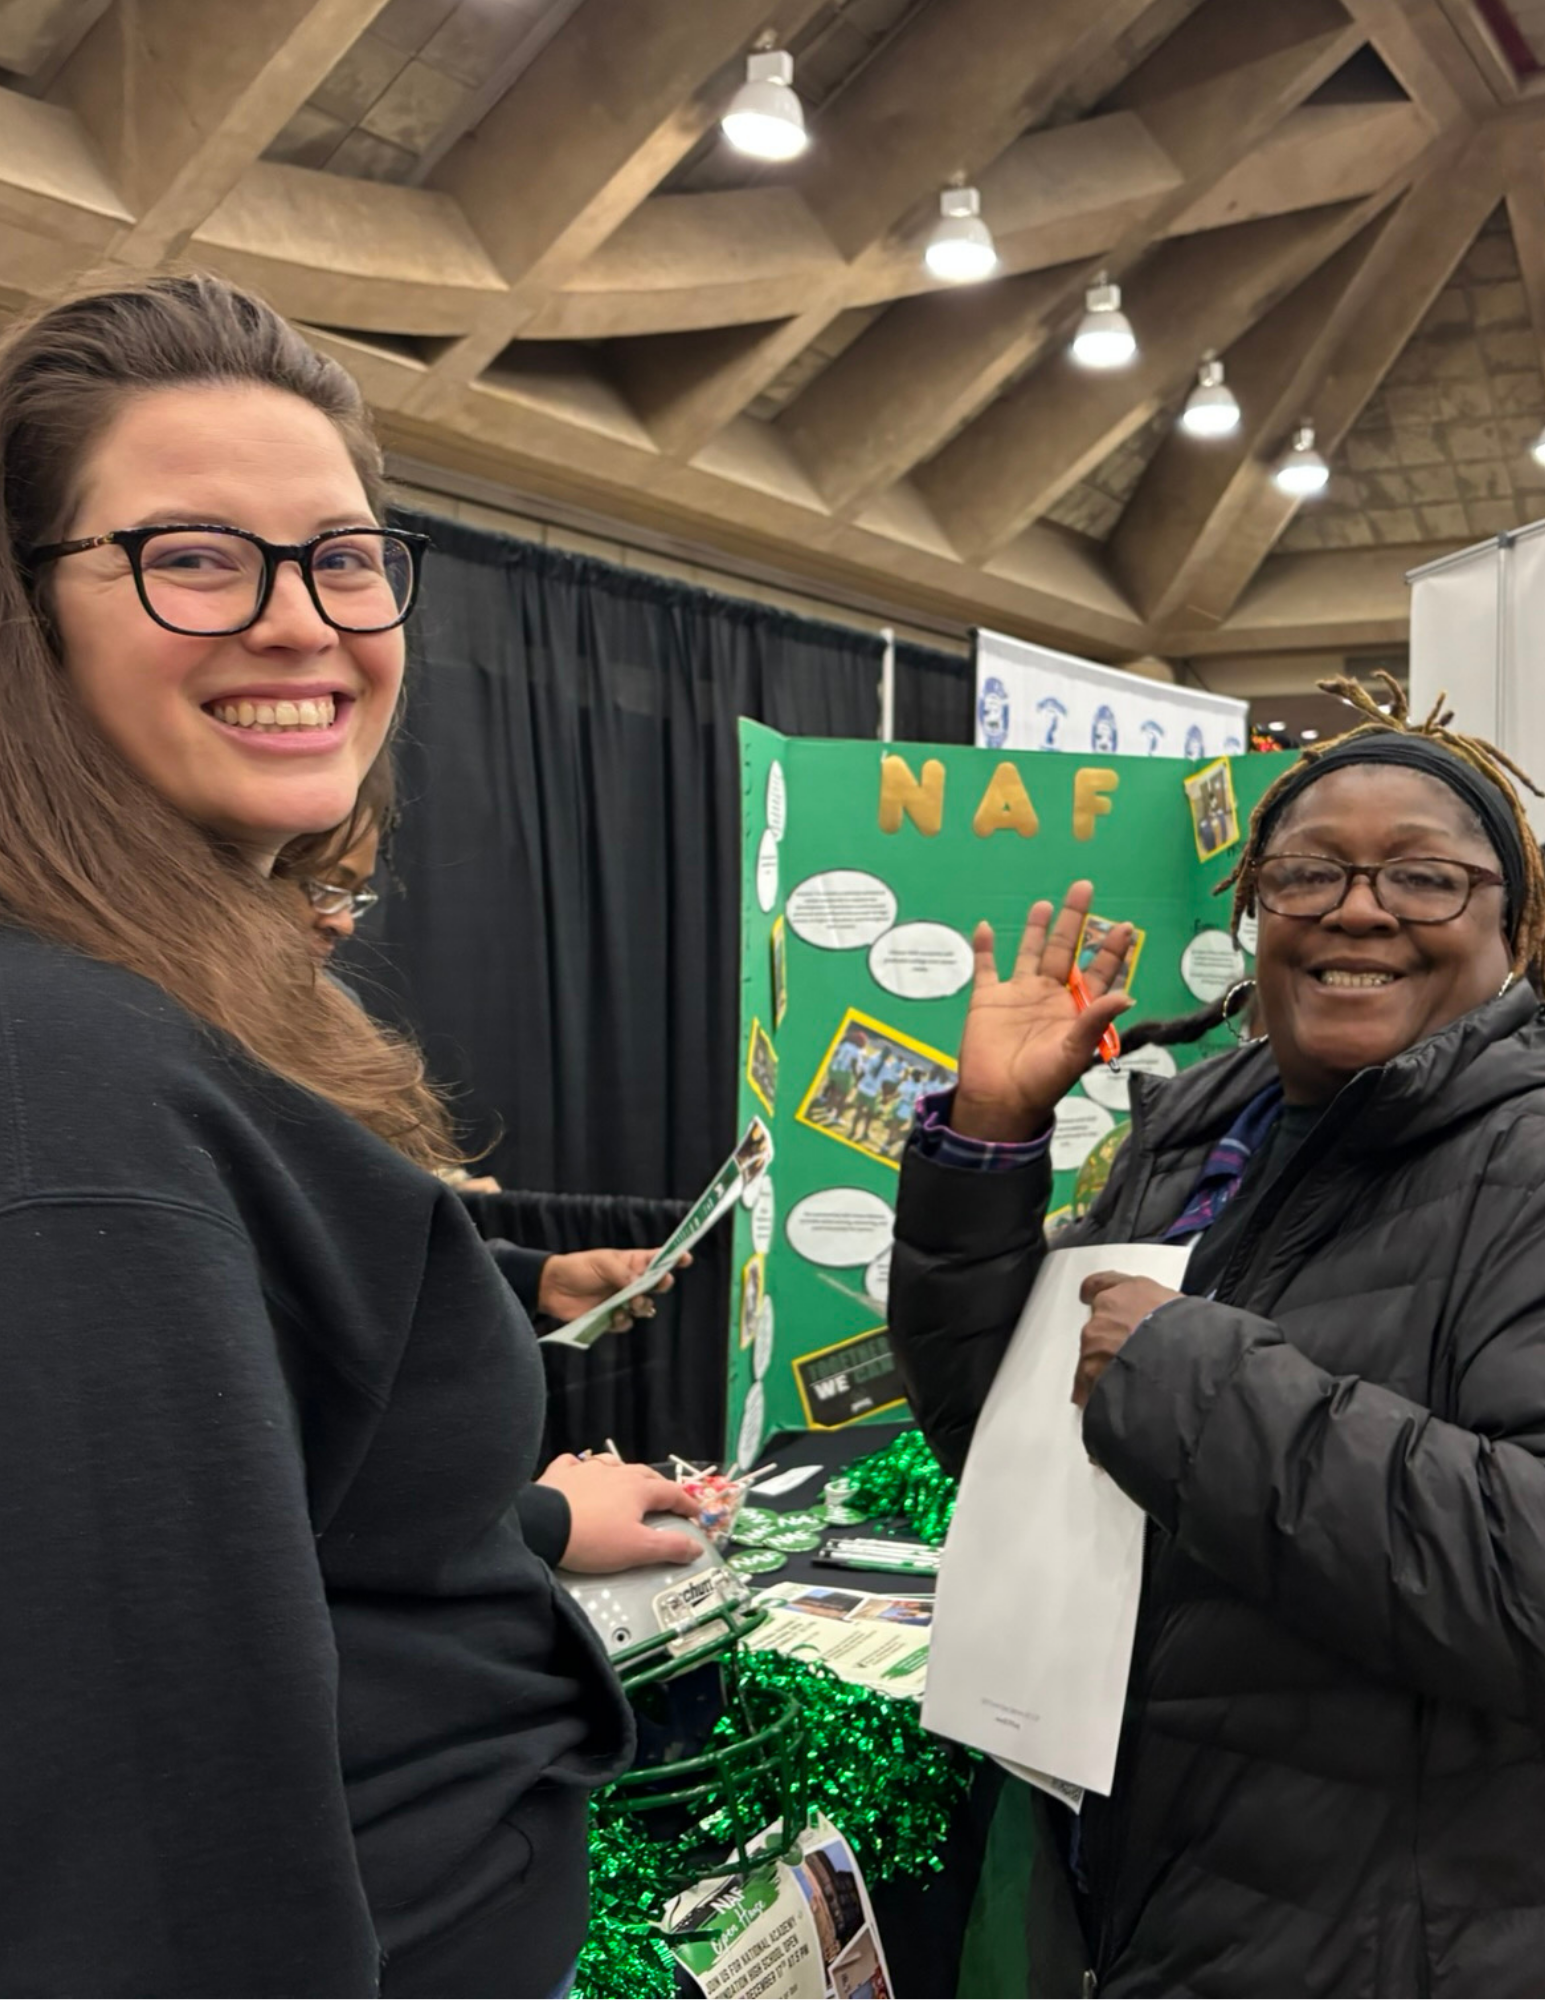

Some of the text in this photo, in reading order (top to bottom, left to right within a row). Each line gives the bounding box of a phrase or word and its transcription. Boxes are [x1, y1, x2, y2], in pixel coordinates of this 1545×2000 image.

[879, 755, 1119, 841] NAF
[813, 1374, 850, 1400] WE
[711, 1887, 745, 1914] NAF
[711, 1924, 738, 1955] Open
[728, 1959, 742, 1977] FOR
[740, 1937, 771, 1965] NATIONAL
[769, 1915, 797, 1943] ACADEMY
[761, 1946, 785, 1970] SCHOOL
[783, 1933, 799, 1953] OPEN
